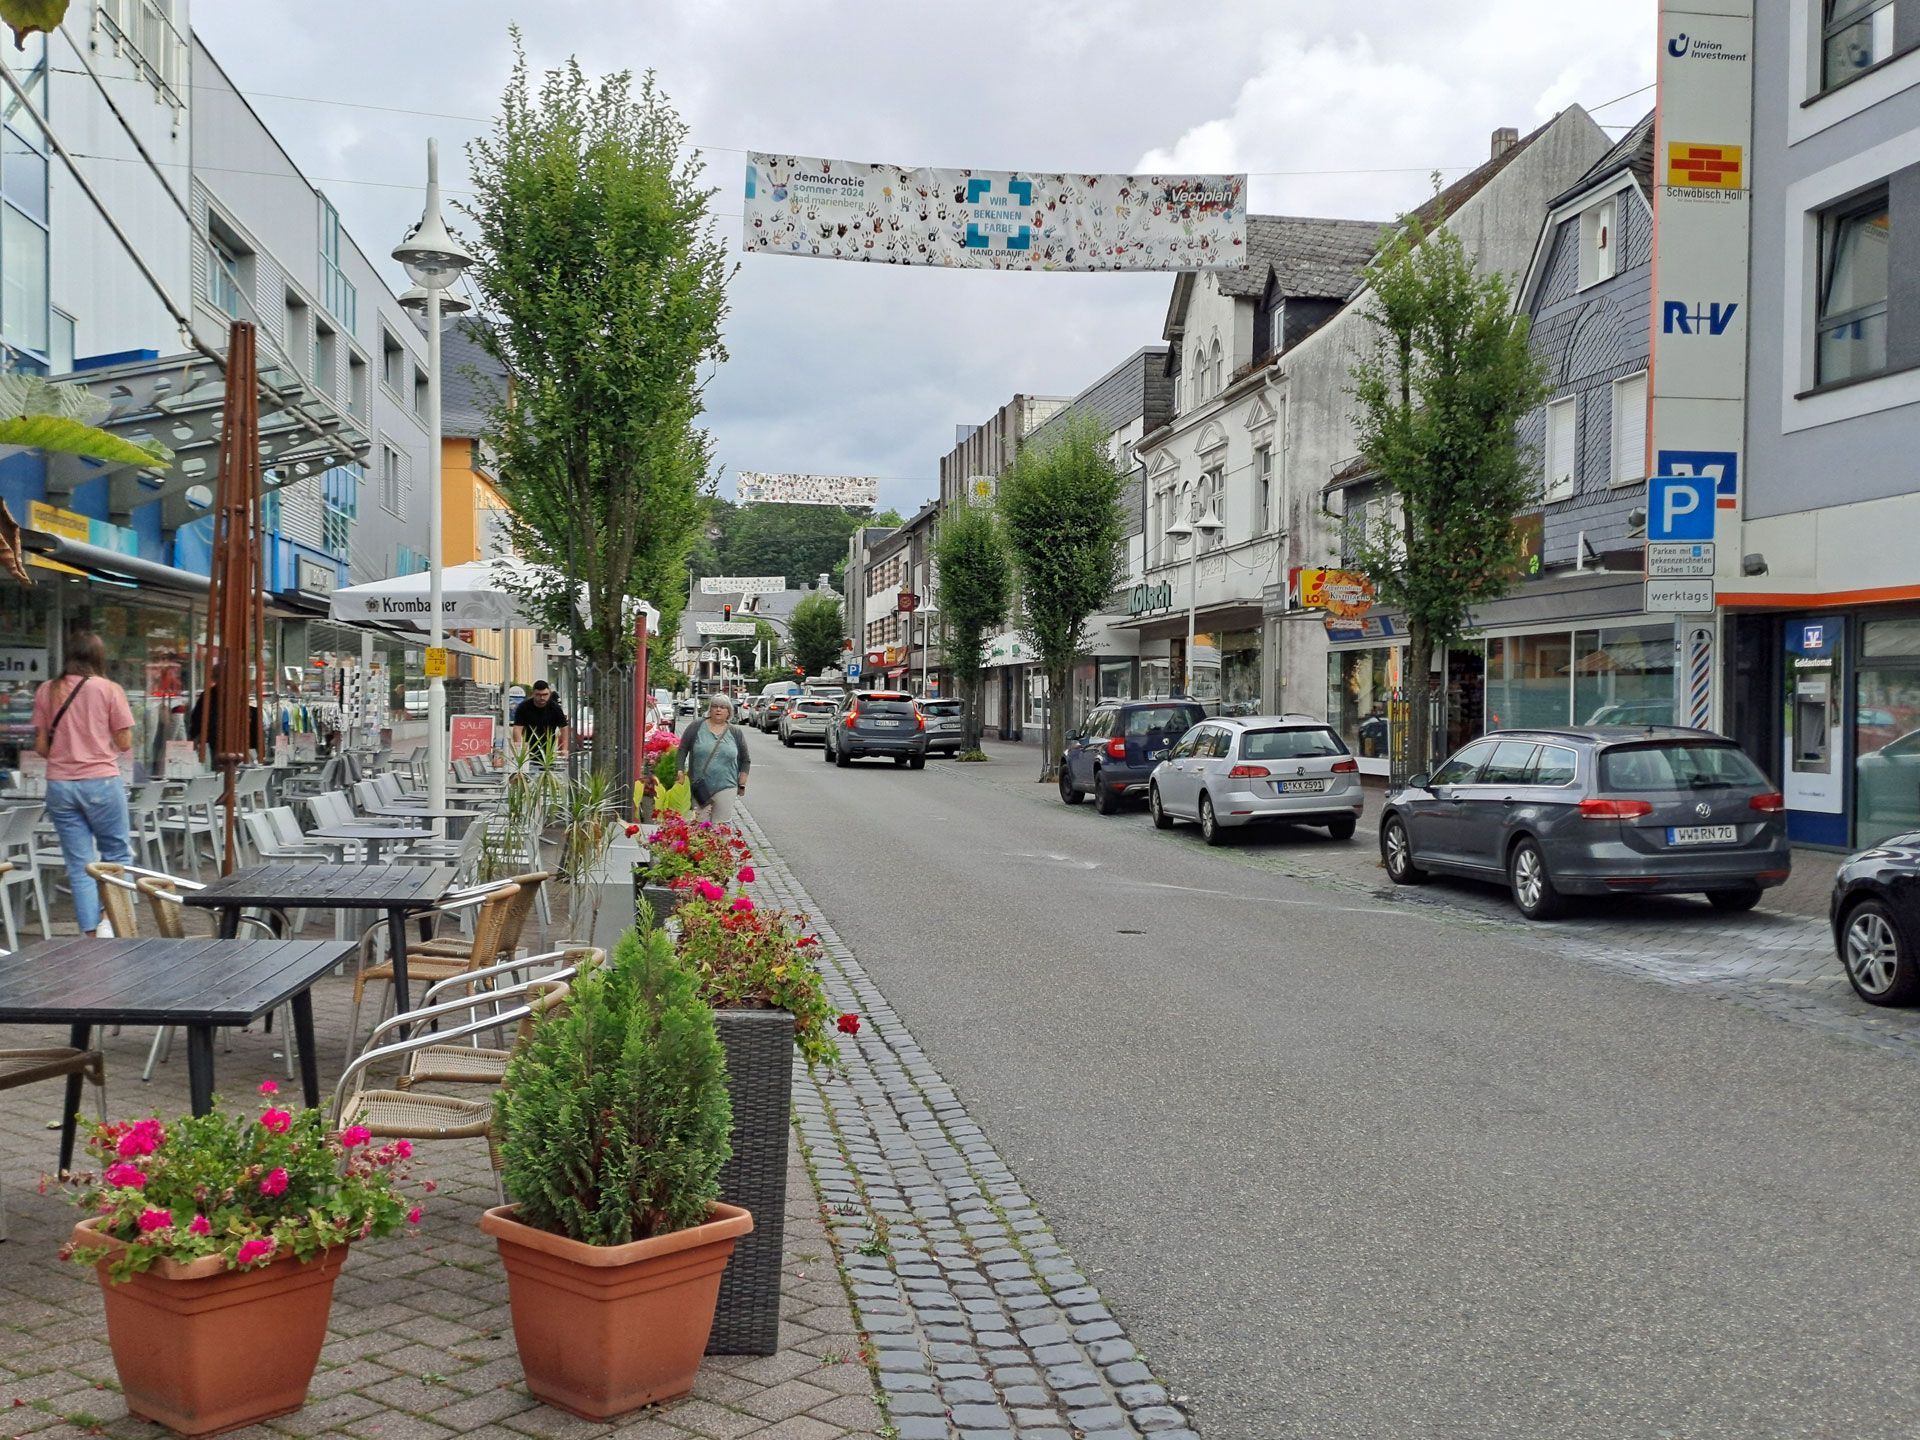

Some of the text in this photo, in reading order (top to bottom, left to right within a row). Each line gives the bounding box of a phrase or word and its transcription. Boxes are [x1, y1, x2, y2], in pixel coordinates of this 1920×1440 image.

[1693, 40, 1722, 50] Union
[1691, 50, 1746, 61] Investment
[794, 171, 865, 187] demokratie
[793, 184, 864, 197] sommer 2024
[1666, 187, 1742, 200] Schwäbisch Hall
[990, 197, 1008, 206] WIR
[1172, 189, 1232, 205] Vecoplan
[974, 209, 1022, 220] BEKENNEN
[984, 223, 1013, 233] FARBE
[1663, 301, 1739, 336] R+V
[1663, 485, 1700, 533] P
[1652, 547, 1677, 555] Parken
[1679, 547, 1691, 555] mit
[1128, 580, 1171, 614] Kölsch
[1651, 591, 1709, 603] werktags
[383, 597, 457, 613] Krombaer
[1794, 658, 1832, 668] Geldautomat
[849, 666, 857, 675] P
[460, 721, 485, 730] SALE
[1304, 781, 1322, 789] 2591
[1678, 827, 1732, 840] WW RN 70
